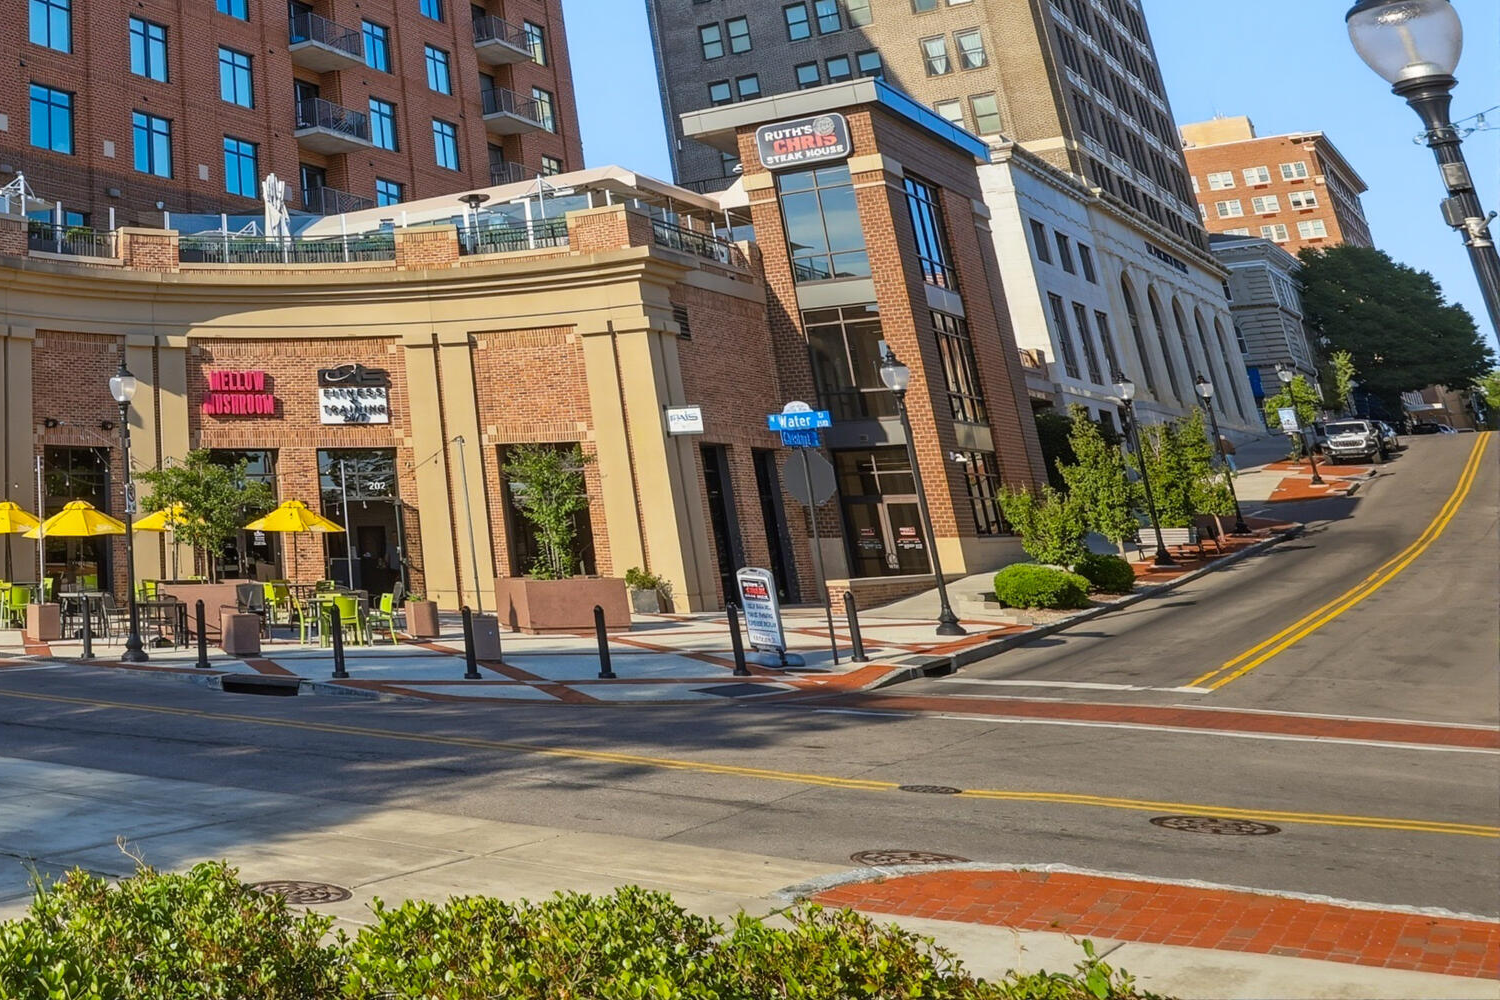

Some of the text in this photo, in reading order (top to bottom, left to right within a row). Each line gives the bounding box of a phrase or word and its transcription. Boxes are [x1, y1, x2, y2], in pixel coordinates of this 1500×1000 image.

[764, 125, 813, 142] RUTH'S
[773, 133, 837, 155] CHRIS
[766, 144, 844, 164] STEAK HOUSE
[209, 370, 264, 391] MELLOW
[323, 388, 385, 399] FITNESS
[202, 393, 274, 415] MUSHROOM
[323, 405, 386, 416] TRAINING
[779, 415, 811, 428] Water
[368, 481, 386, 490] 202
